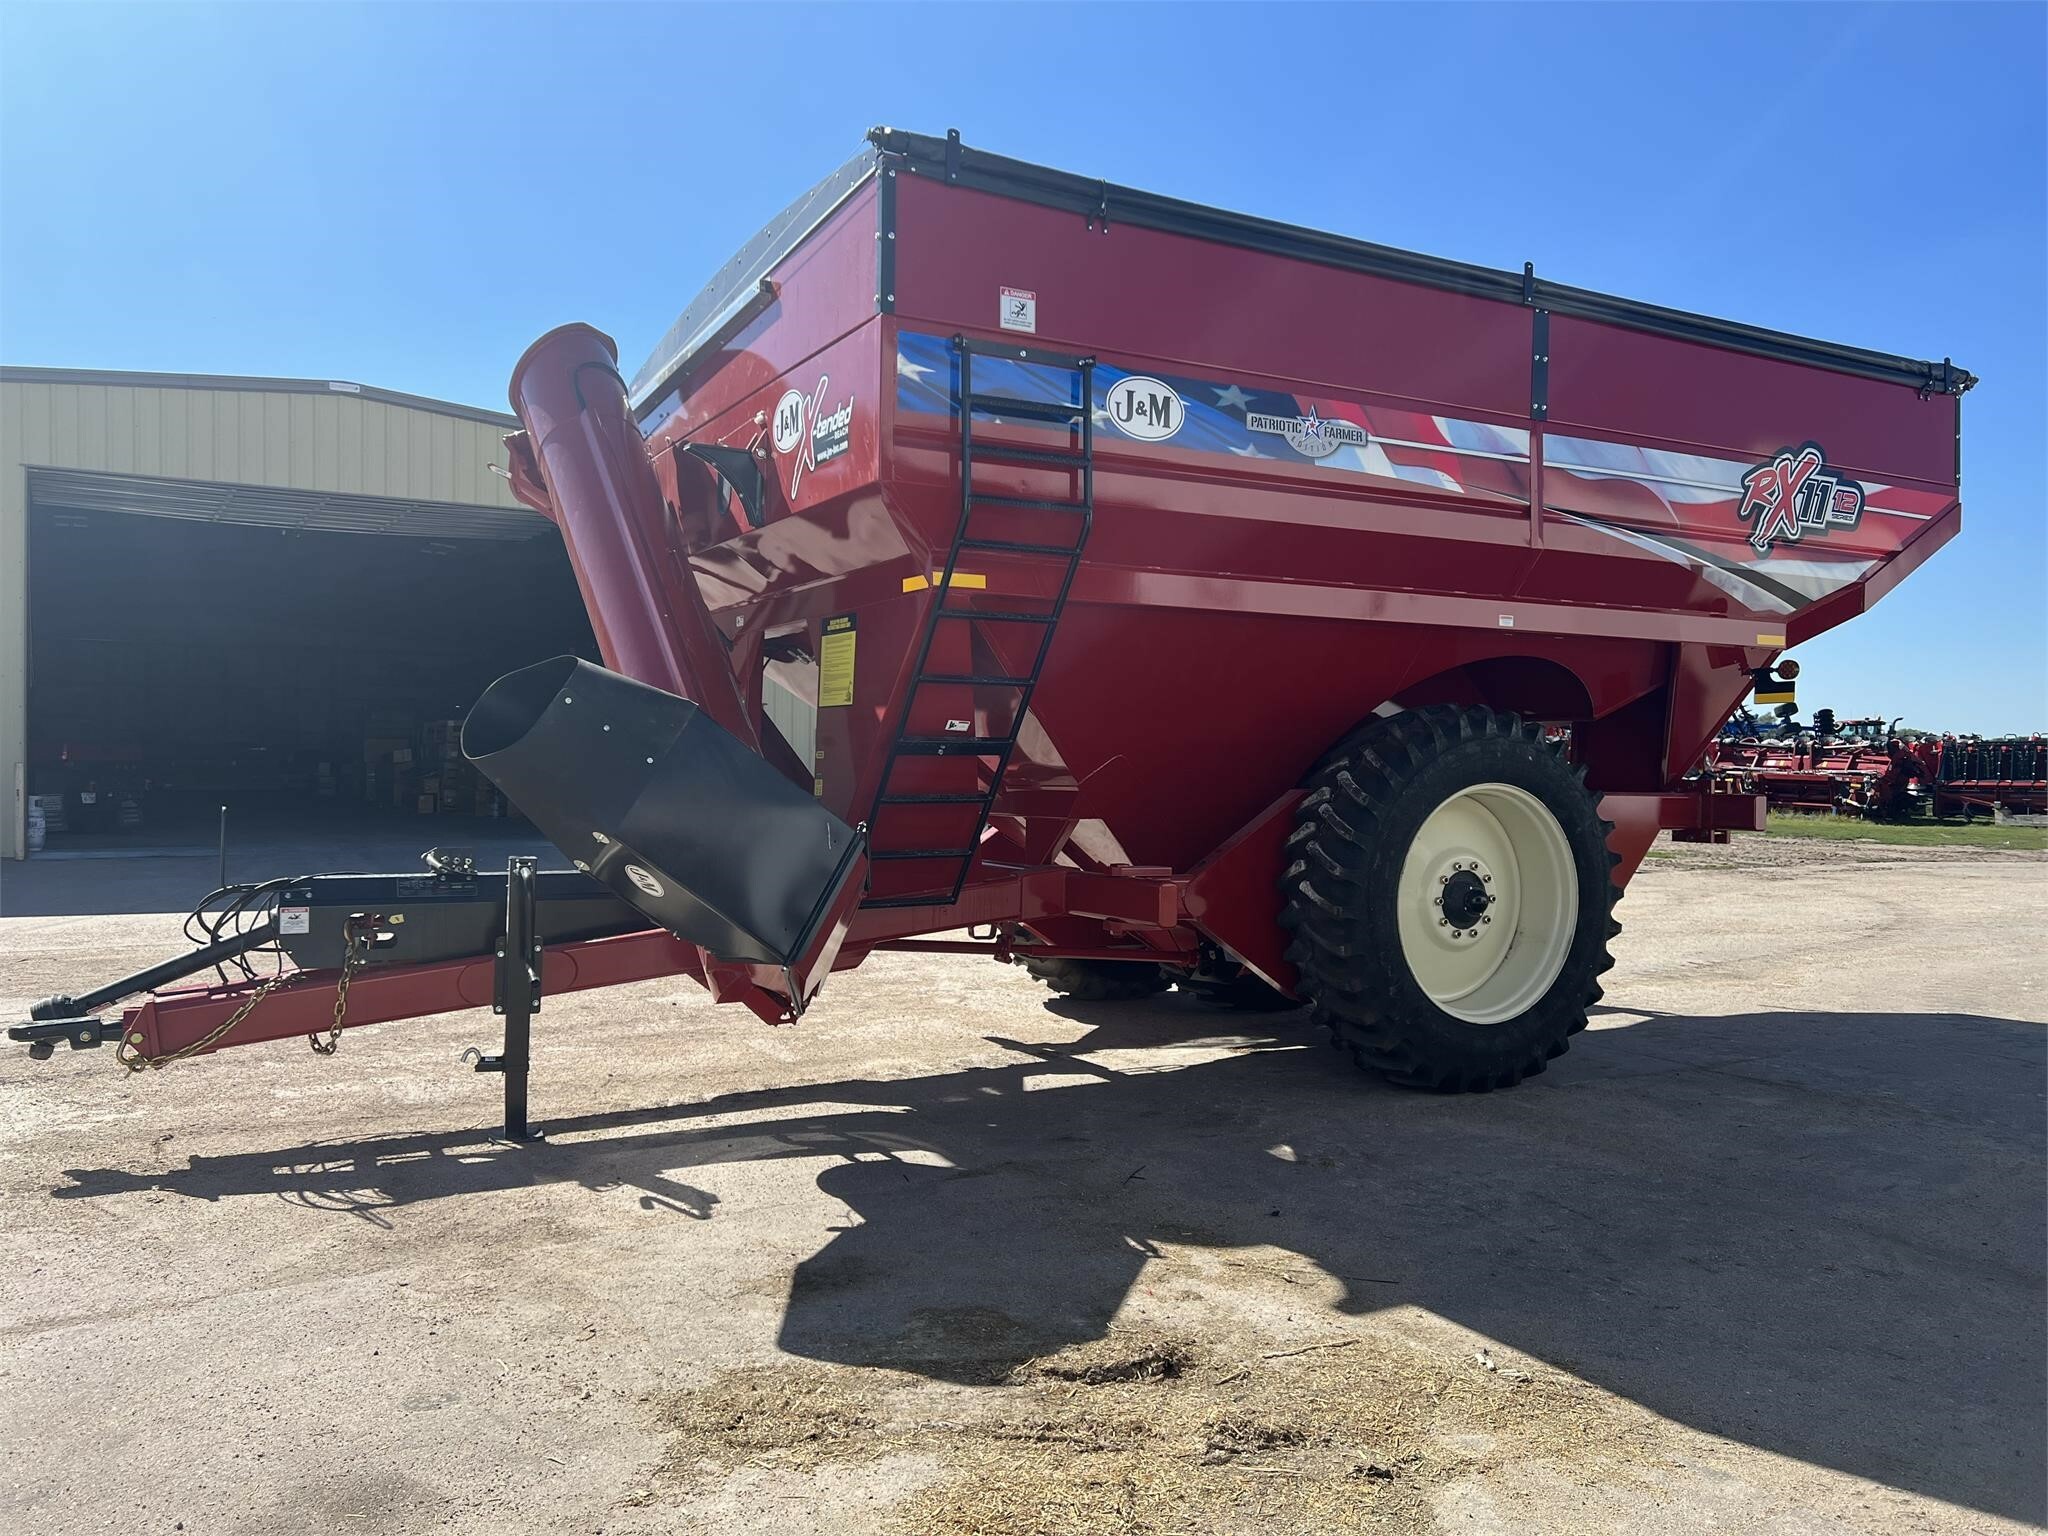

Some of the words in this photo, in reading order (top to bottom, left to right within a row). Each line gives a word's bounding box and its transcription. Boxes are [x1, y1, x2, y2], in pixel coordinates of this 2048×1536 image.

[776, 401, 800, 442] J&M
[1115, 389, 1171, 429] J&M
[1251, 415, 1302, 434] PATRIOTIC
[1324, 426, 1363, 442] FARMER
